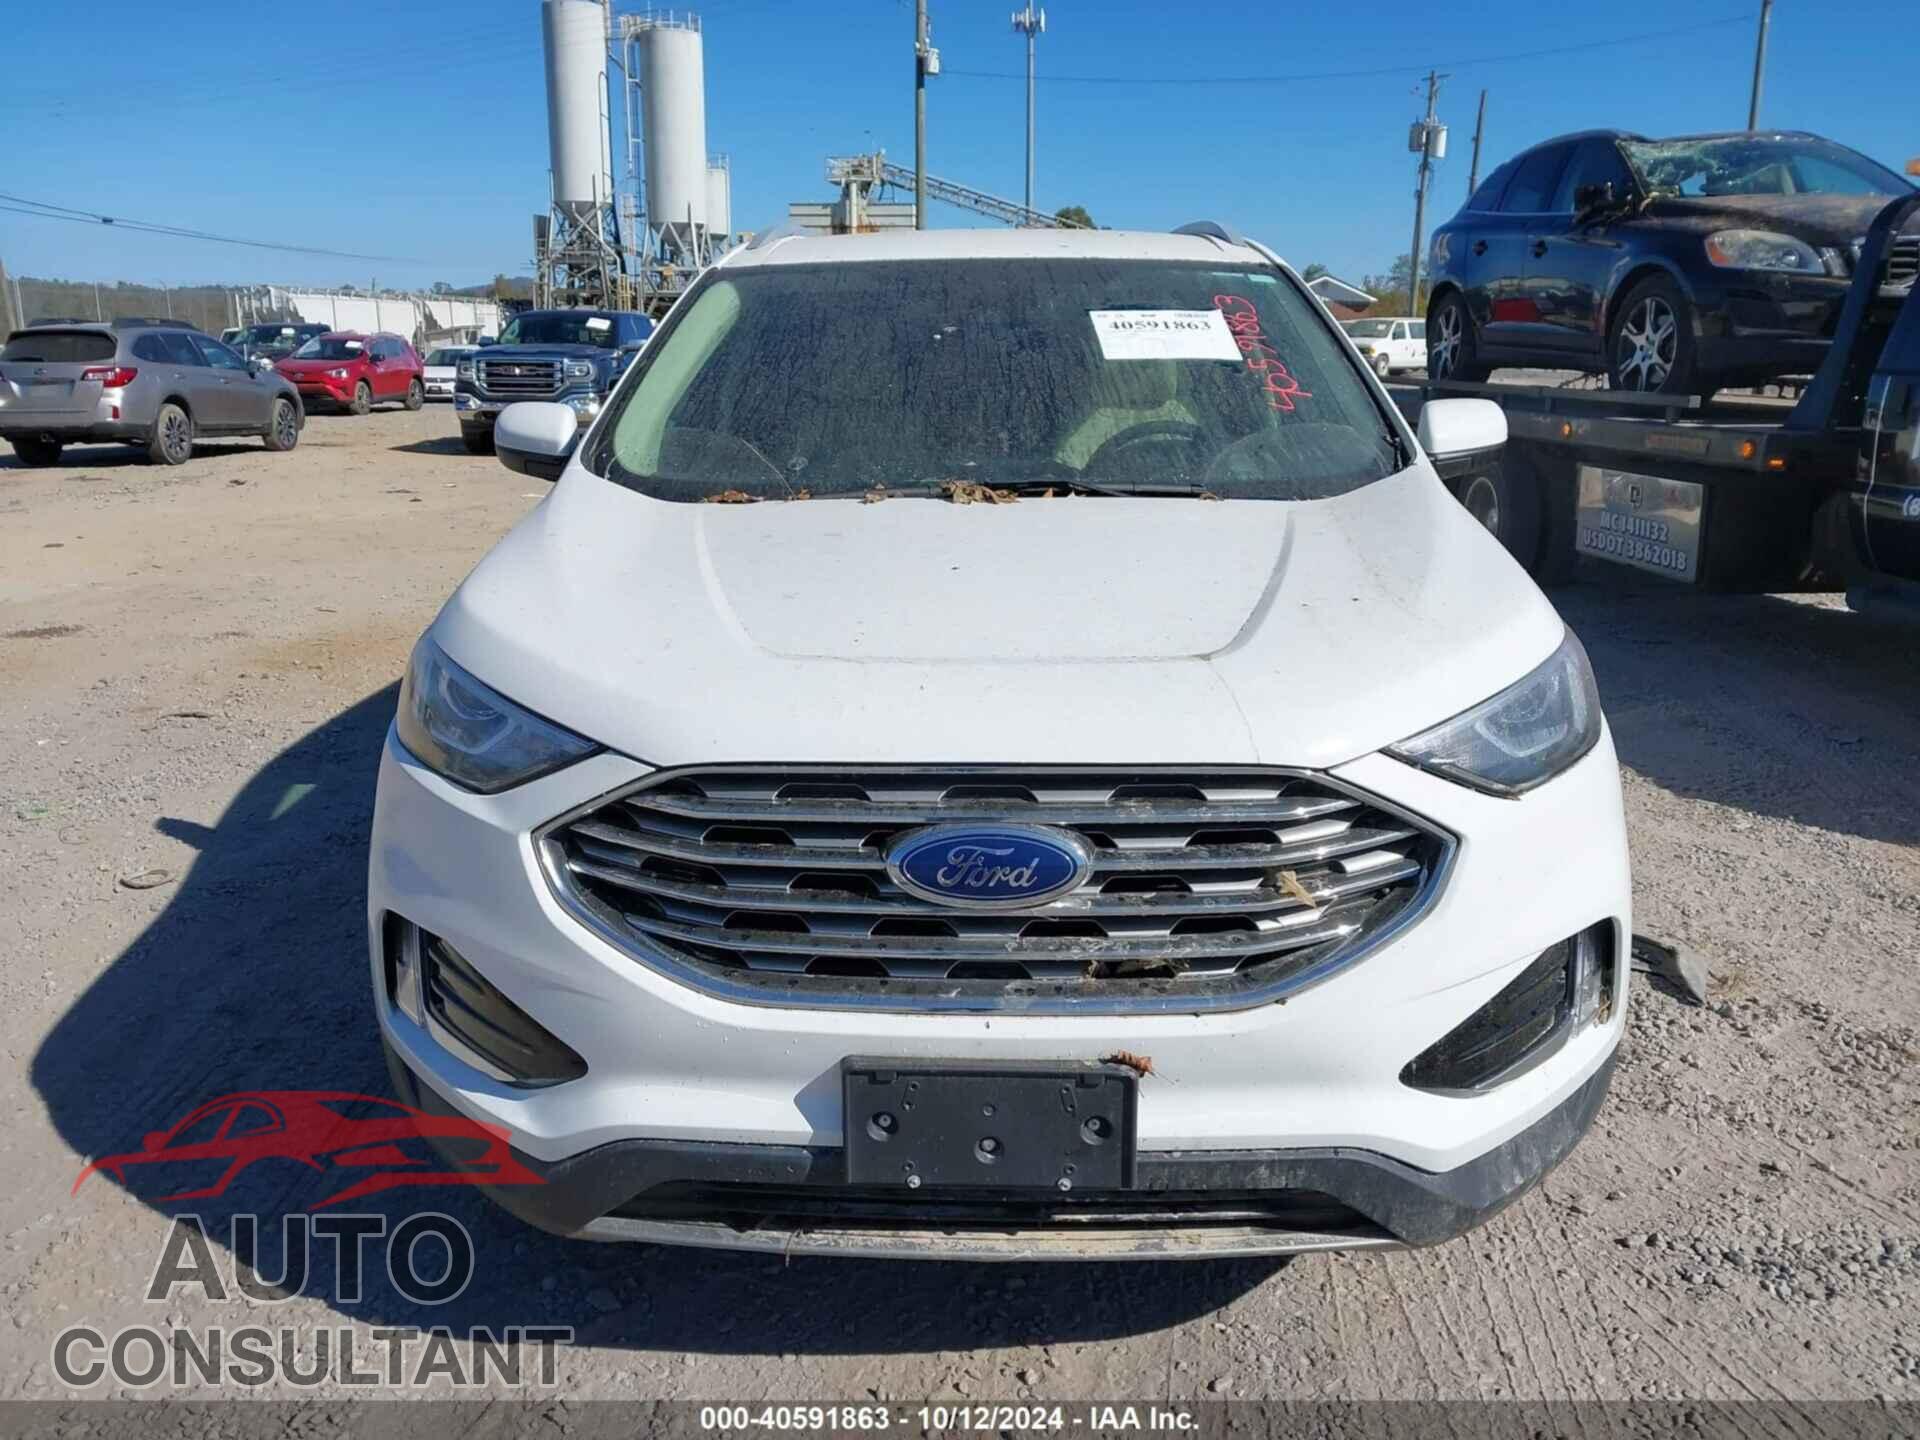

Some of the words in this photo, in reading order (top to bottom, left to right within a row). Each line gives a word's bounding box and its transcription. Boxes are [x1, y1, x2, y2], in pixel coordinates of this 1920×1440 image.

[1108, 319, 1212, 331] 40591863
[1582, 528, 1624, 556] USDOT
[1626, 539, 1688, 571] 3862018
[936, 845, 1041, 887] Ford
